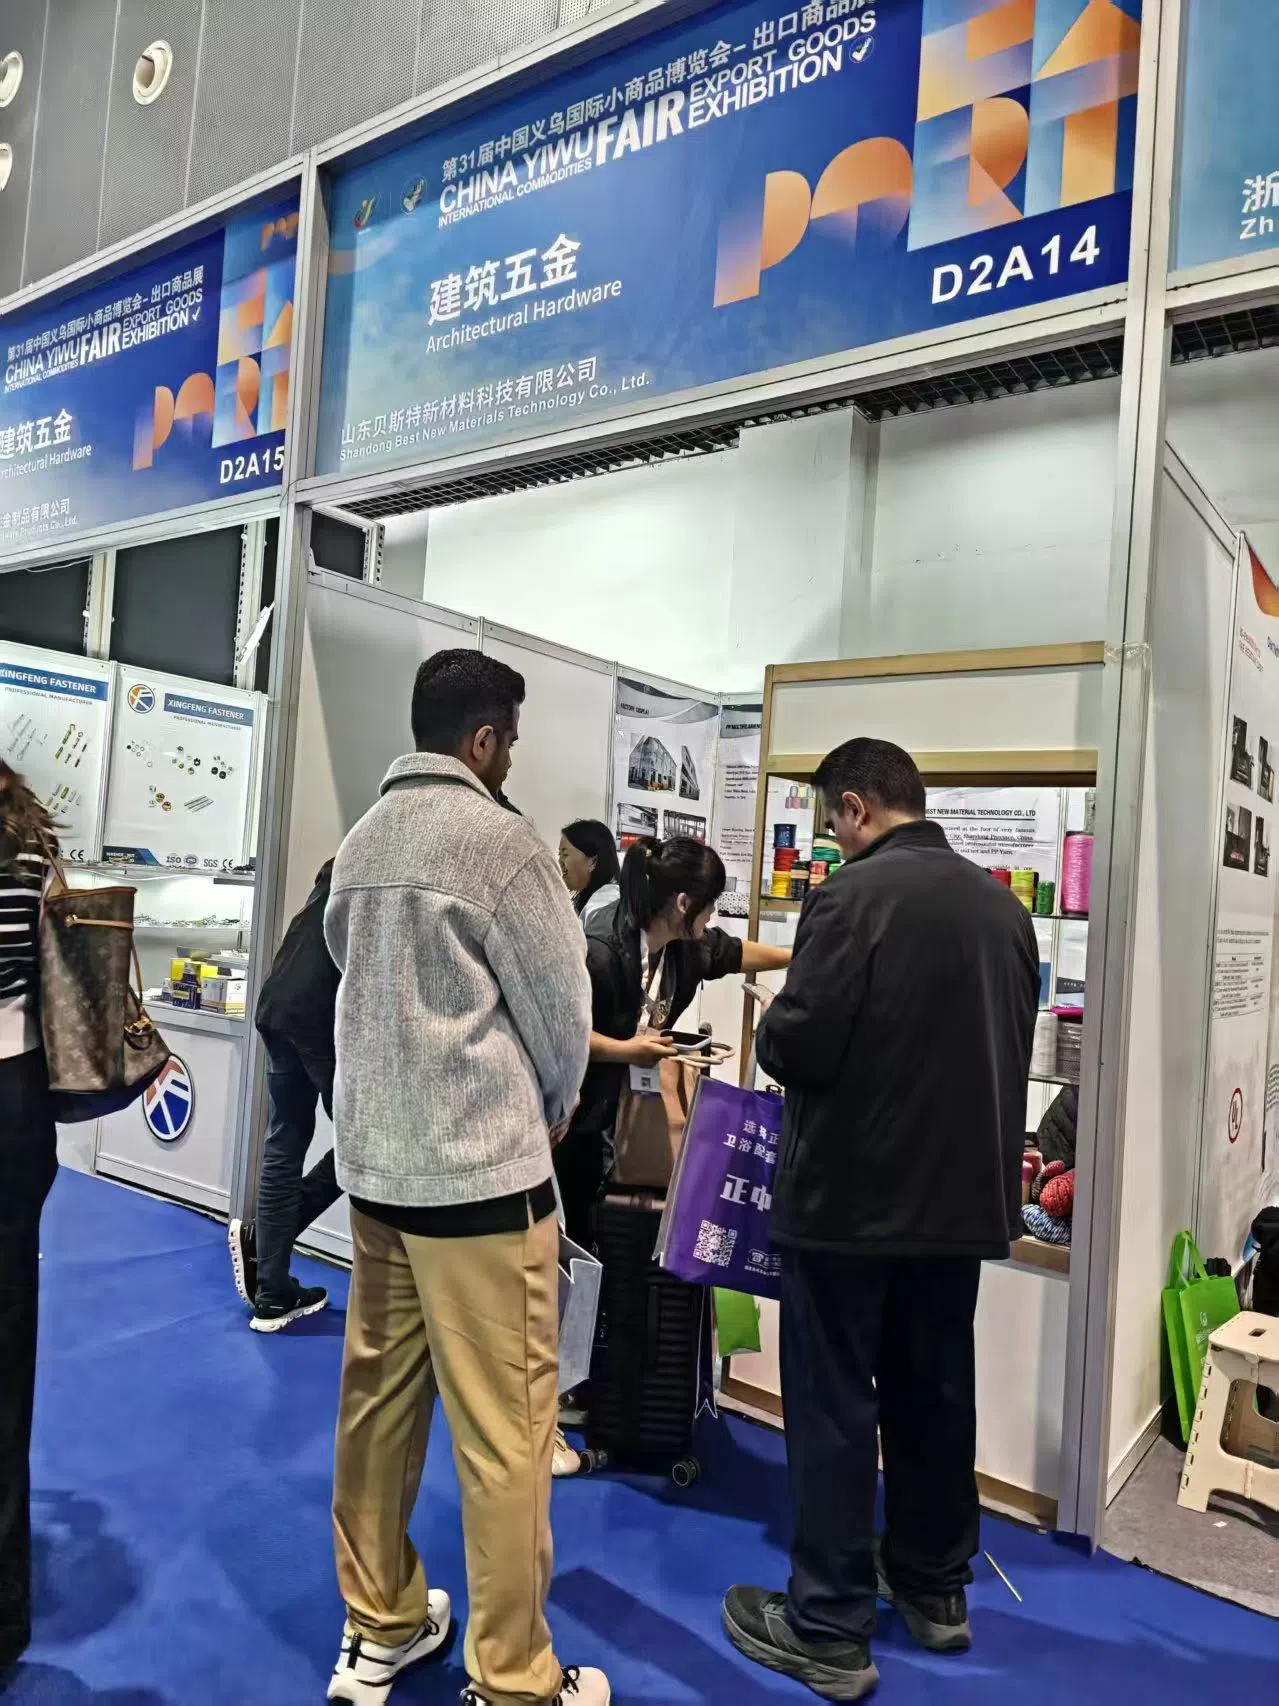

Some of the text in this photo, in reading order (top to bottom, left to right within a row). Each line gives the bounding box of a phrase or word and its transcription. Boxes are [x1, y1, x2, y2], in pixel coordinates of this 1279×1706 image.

[690, 9, 876, 102] EXPORT GOODS
[439, 44, 842, 214] CHINA YIWU FAIR EXHIBITION
[438, 157, 592, 229] INTERNATIONAL COMMODITIES
[1241, 170, 1279, 213] 浙
[1240, 215, 1274, 240] Zh
[427, 233, 581, 326] 建筑五金
[931, 225, 1101, 305] D2A14
[122, 288, 203, 332] EXPORT GOODS
[426, 278, 622, 353] Architectural Hardware
[5, 308, 190, 384] CHINA YIWU FAIR EXHIBITION
[4, 360, 79, 394] INTERNATIONAL COMMODITIES
[339, 371, 651, 461] Shandong Best New Materials Technology Co., Ltd.
[340, 356, 598, 445] 山东贝斯特新材料科技有限公司
[49, 444, 92, 465] Hardware
[220, 445, 285, 484] D2A15
[5, 686, 47, 699] PROFESSIONAL
[49, 678, 97, 694] FASTENER
[168, 699, 244, 720] XINGFENG FASTENER
[950, 808, 976, 816] MATERIAL
[977, 809, 1013, 817] TECHNOLOGY
[166, 855, 182, 864] ISO
[203, 858, 218, 868] SGS
